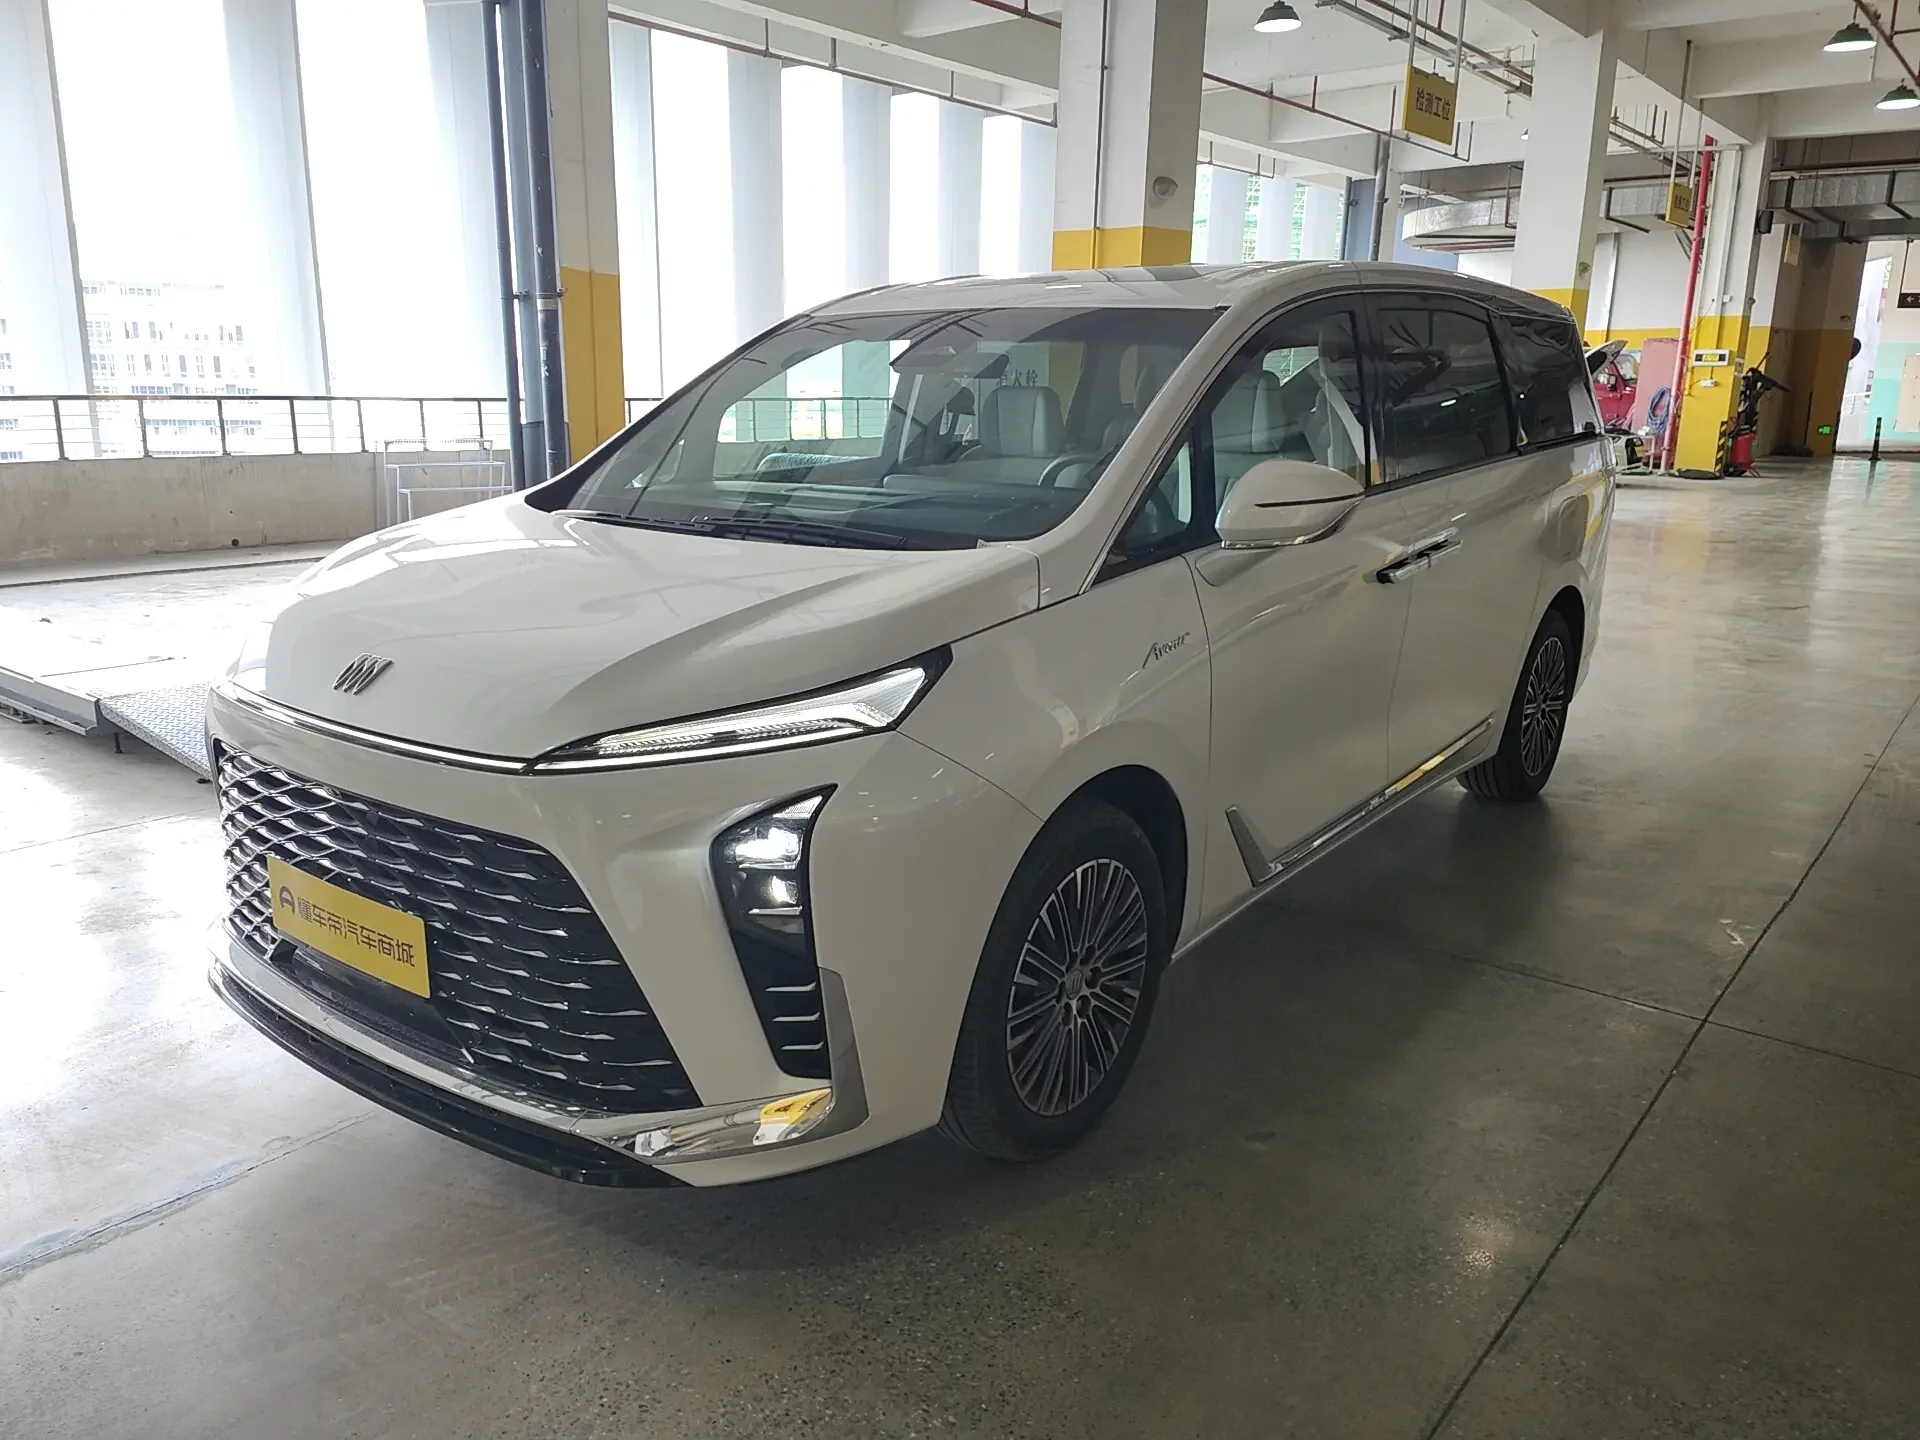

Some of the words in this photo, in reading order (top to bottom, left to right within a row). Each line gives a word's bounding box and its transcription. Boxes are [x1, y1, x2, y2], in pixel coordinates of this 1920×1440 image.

[1416, 87, 1451, 121] 检测工位
[298, 896, 415, 967] 懂车帝汽车商城
